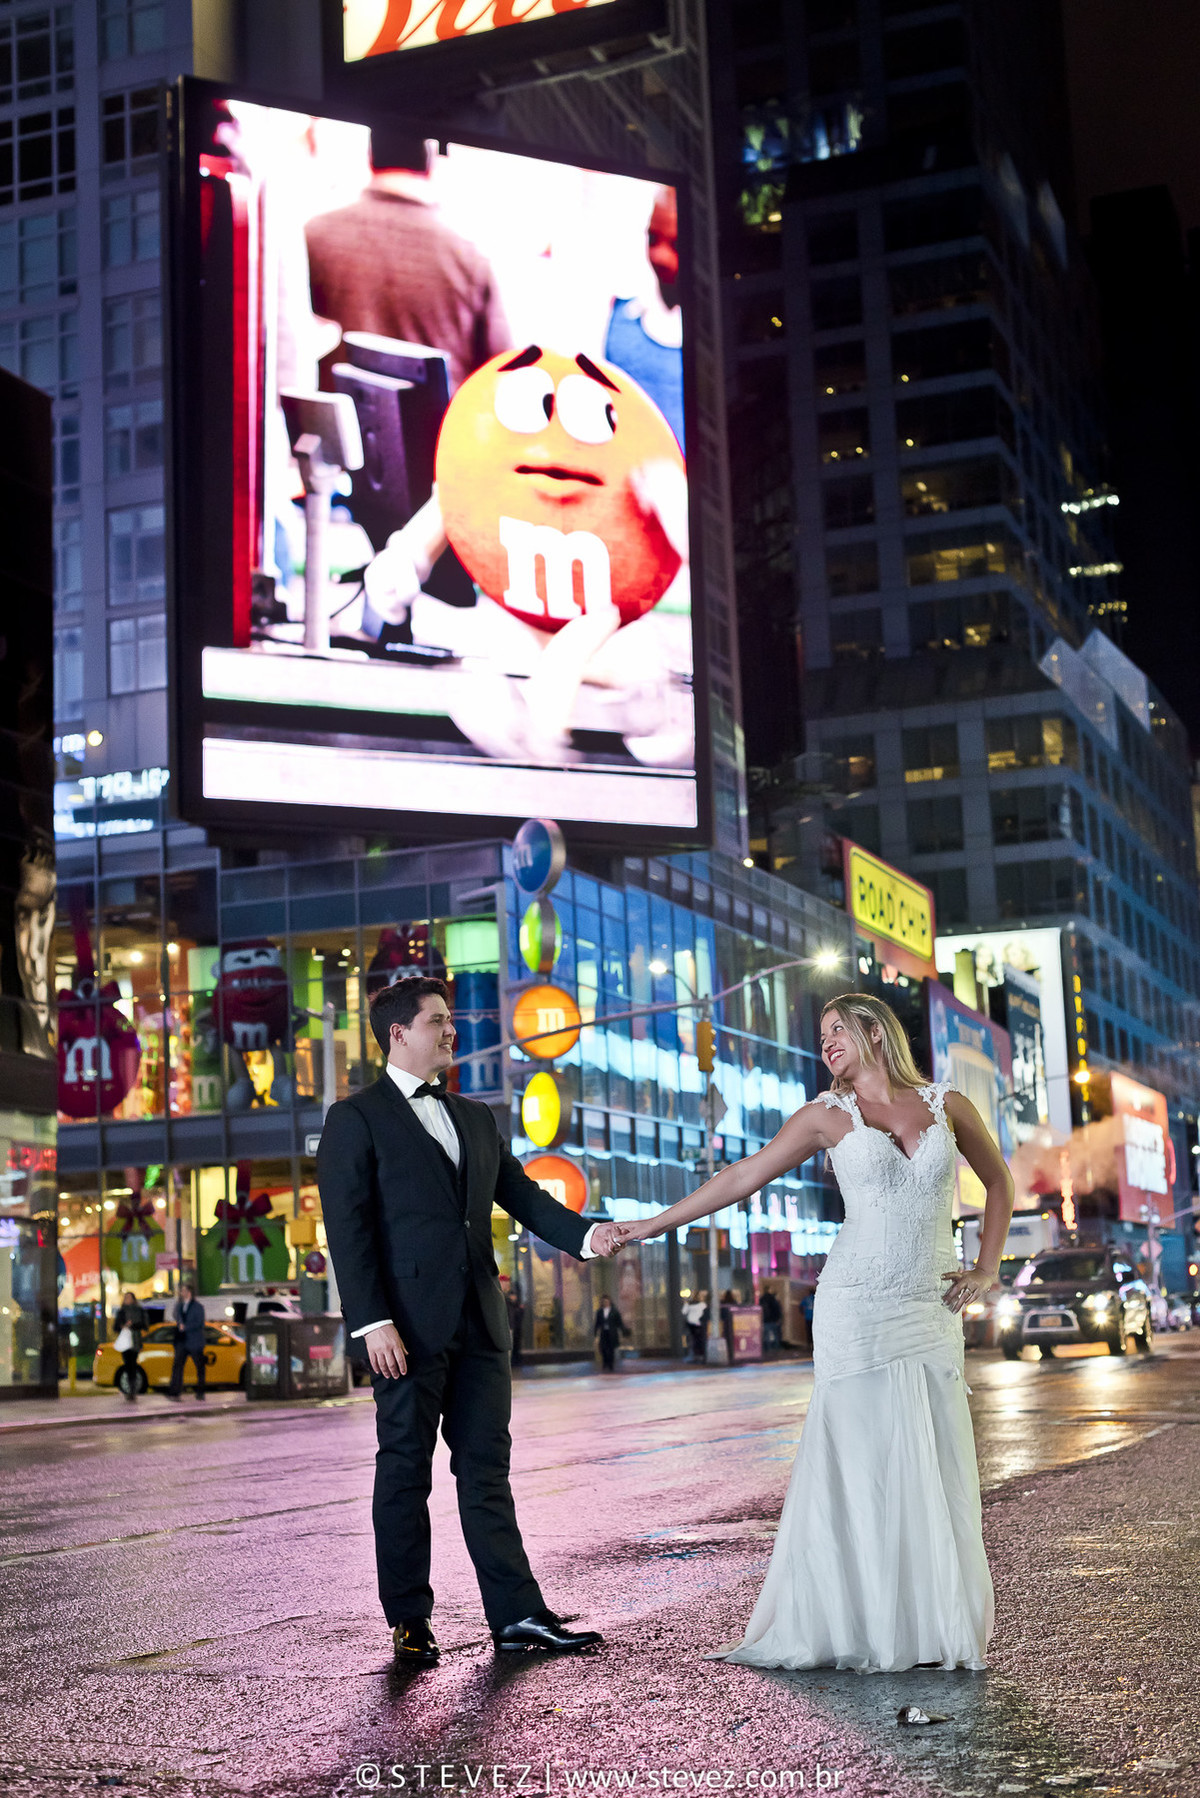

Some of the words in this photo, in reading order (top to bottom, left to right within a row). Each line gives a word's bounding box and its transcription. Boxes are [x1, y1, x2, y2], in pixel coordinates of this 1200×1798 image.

[499, 516, 613, 619] m
[858, 875, 896, 930] ROAD
[537, 1008, 565, 1033] m
